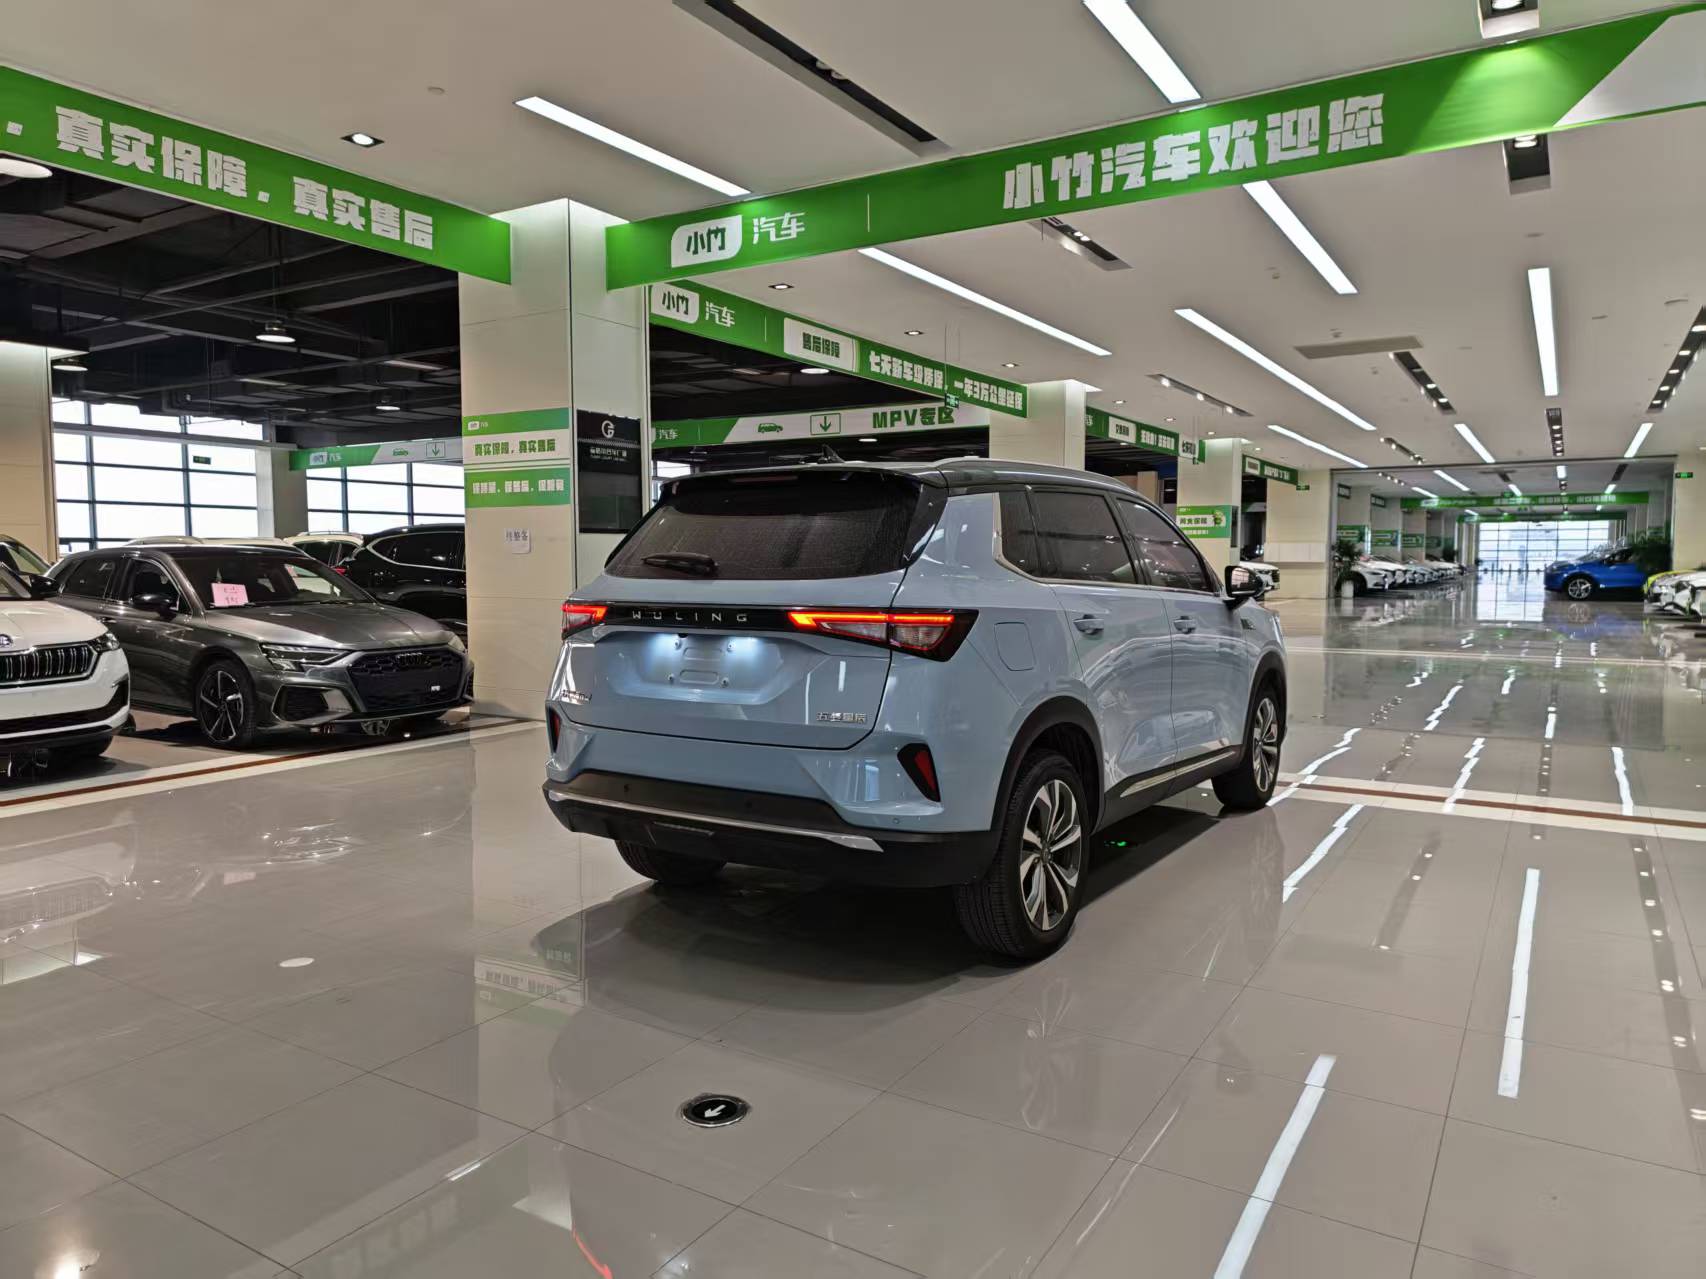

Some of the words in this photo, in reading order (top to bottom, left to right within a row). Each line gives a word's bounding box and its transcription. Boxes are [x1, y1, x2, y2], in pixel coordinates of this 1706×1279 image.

[1002, 92, 1386, 210] 小竹汽车欢迎您
[685, 226, 727, 256] 小竹
[753, 211, 806, 245] 汽车
[662, 290, 690, 316] 小竹
[705, 300, 736, 328] 汽车
[631, 609, 749, 623] WULING
